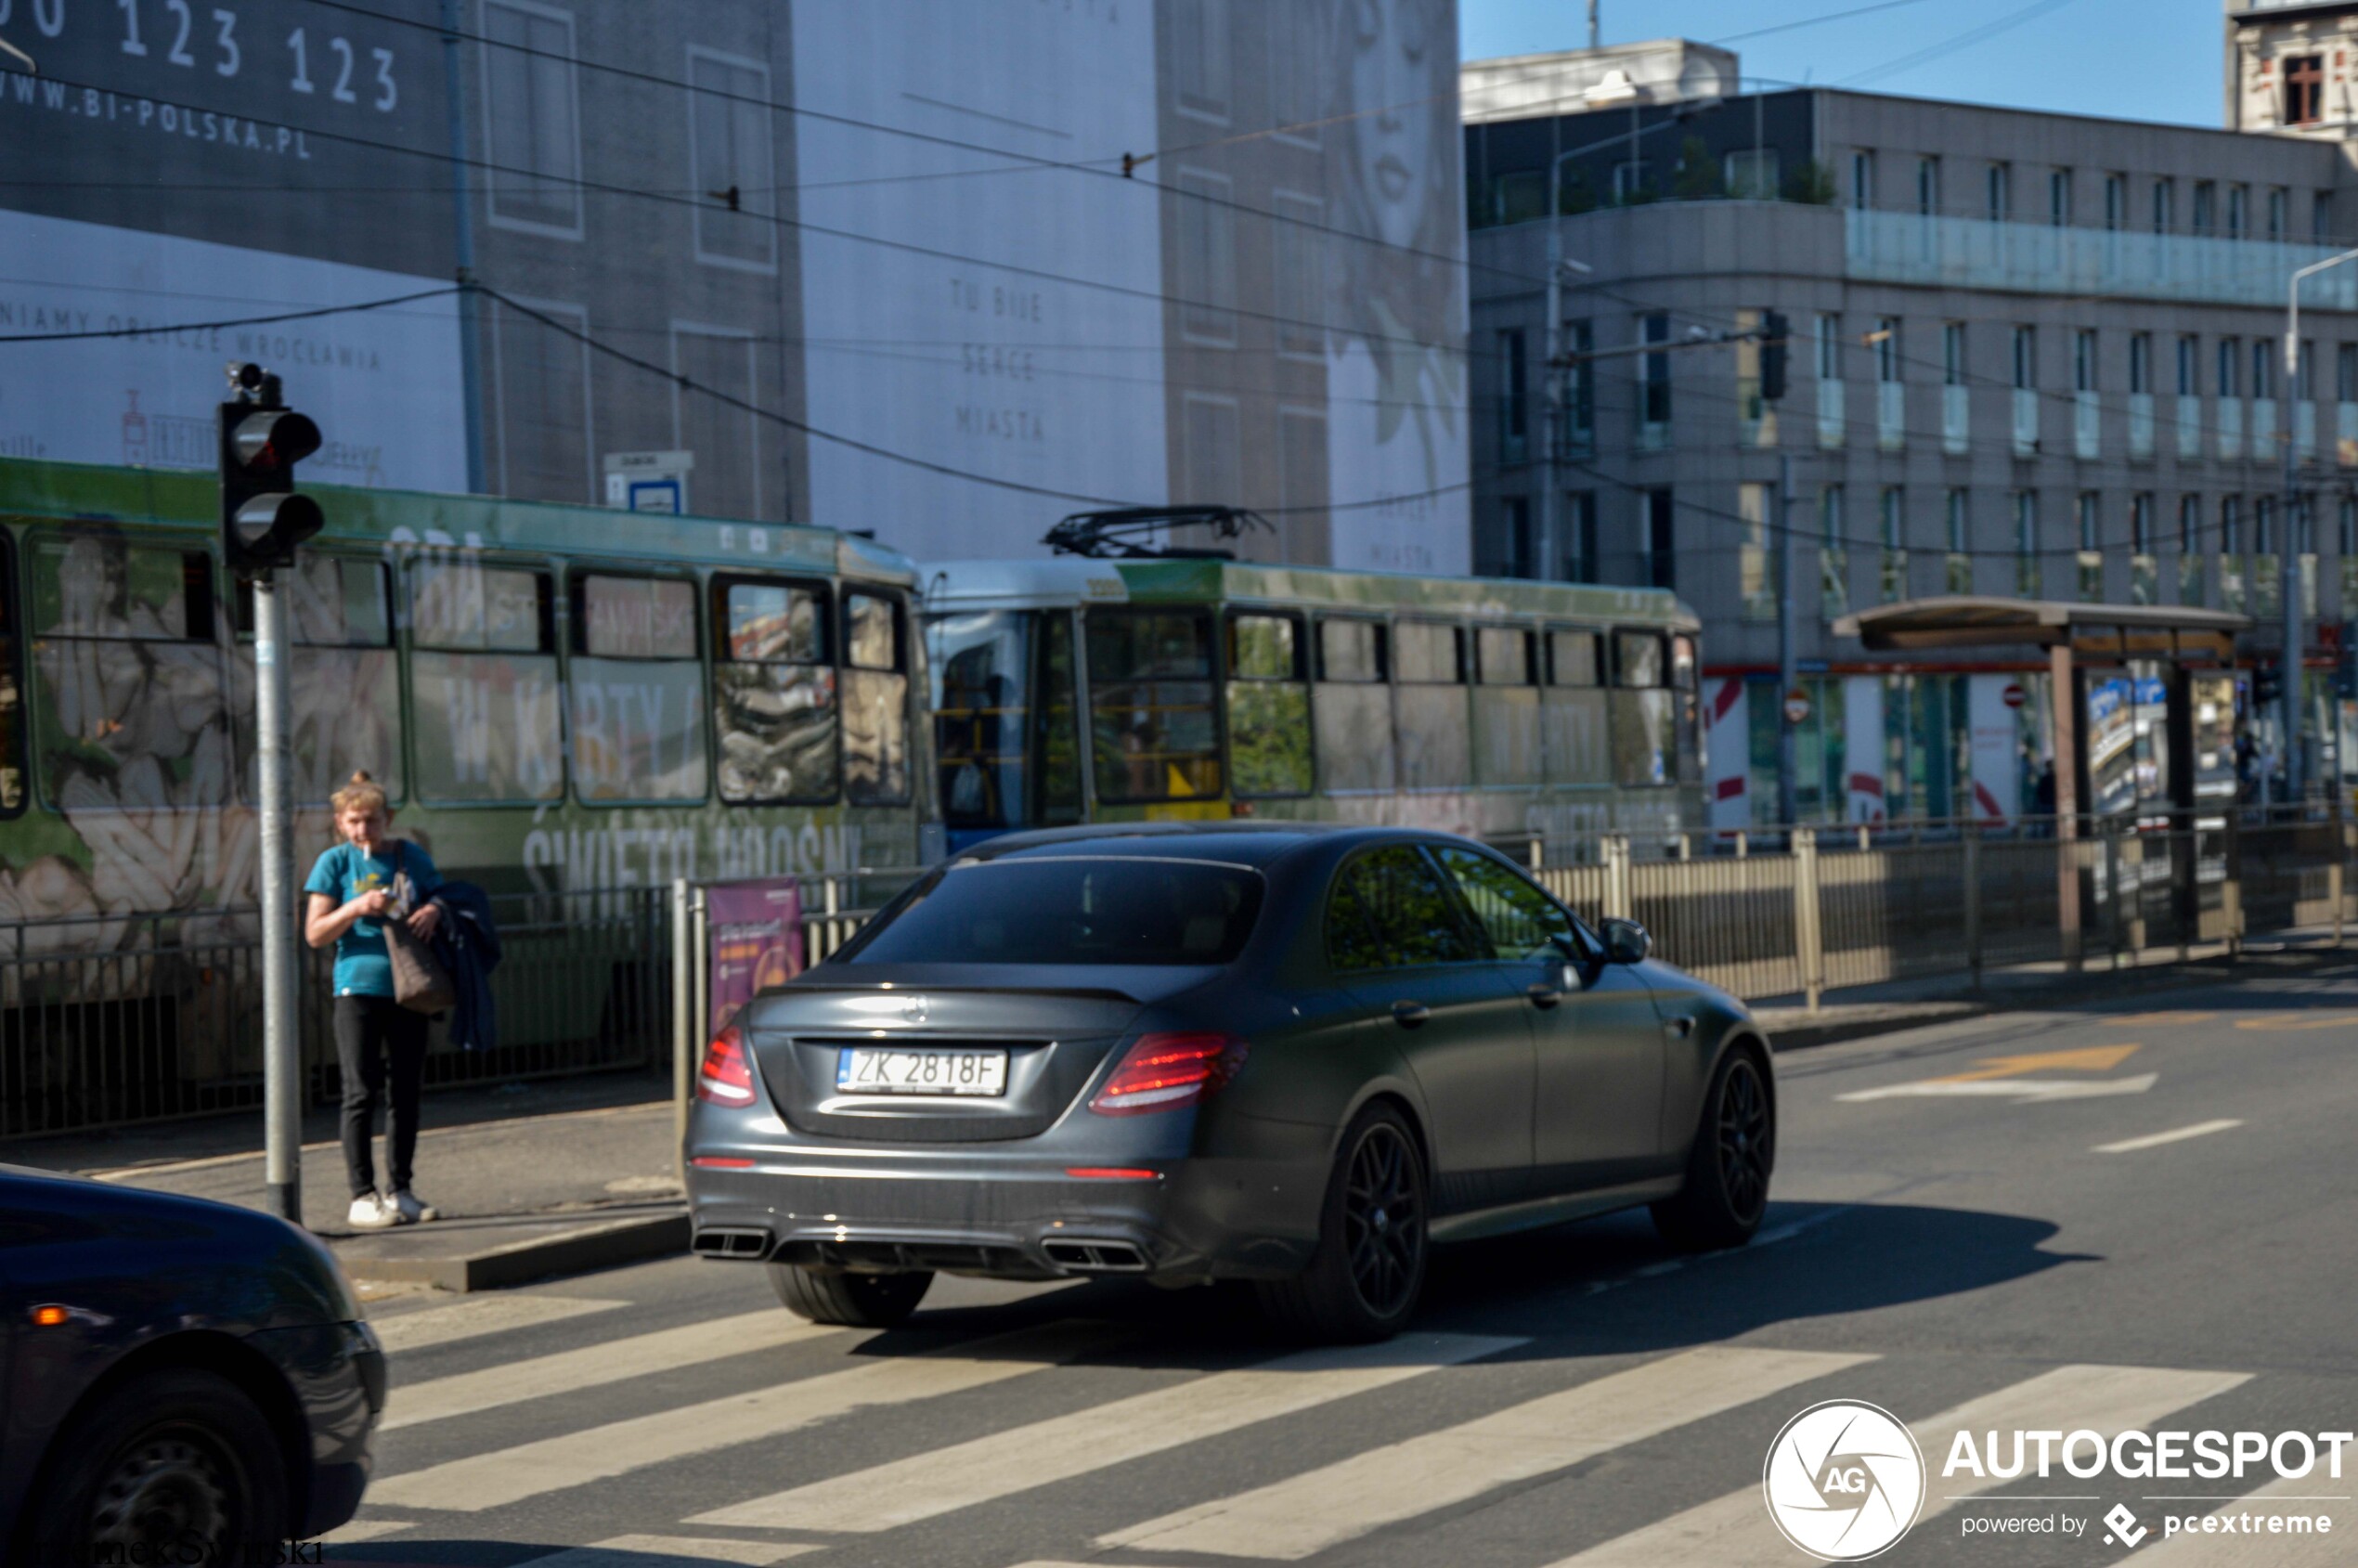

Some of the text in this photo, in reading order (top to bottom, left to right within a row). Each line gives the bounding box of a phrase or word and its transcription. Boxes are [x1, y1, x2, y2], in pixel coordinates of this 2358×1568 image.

[117, 0, 240, 76] 123
[287, 26, 397, 111] 123
[0, 69, 310, 160] WW.BI-POLSKA.PL
[857, 1050, 998, 1084] ZK 2818F
